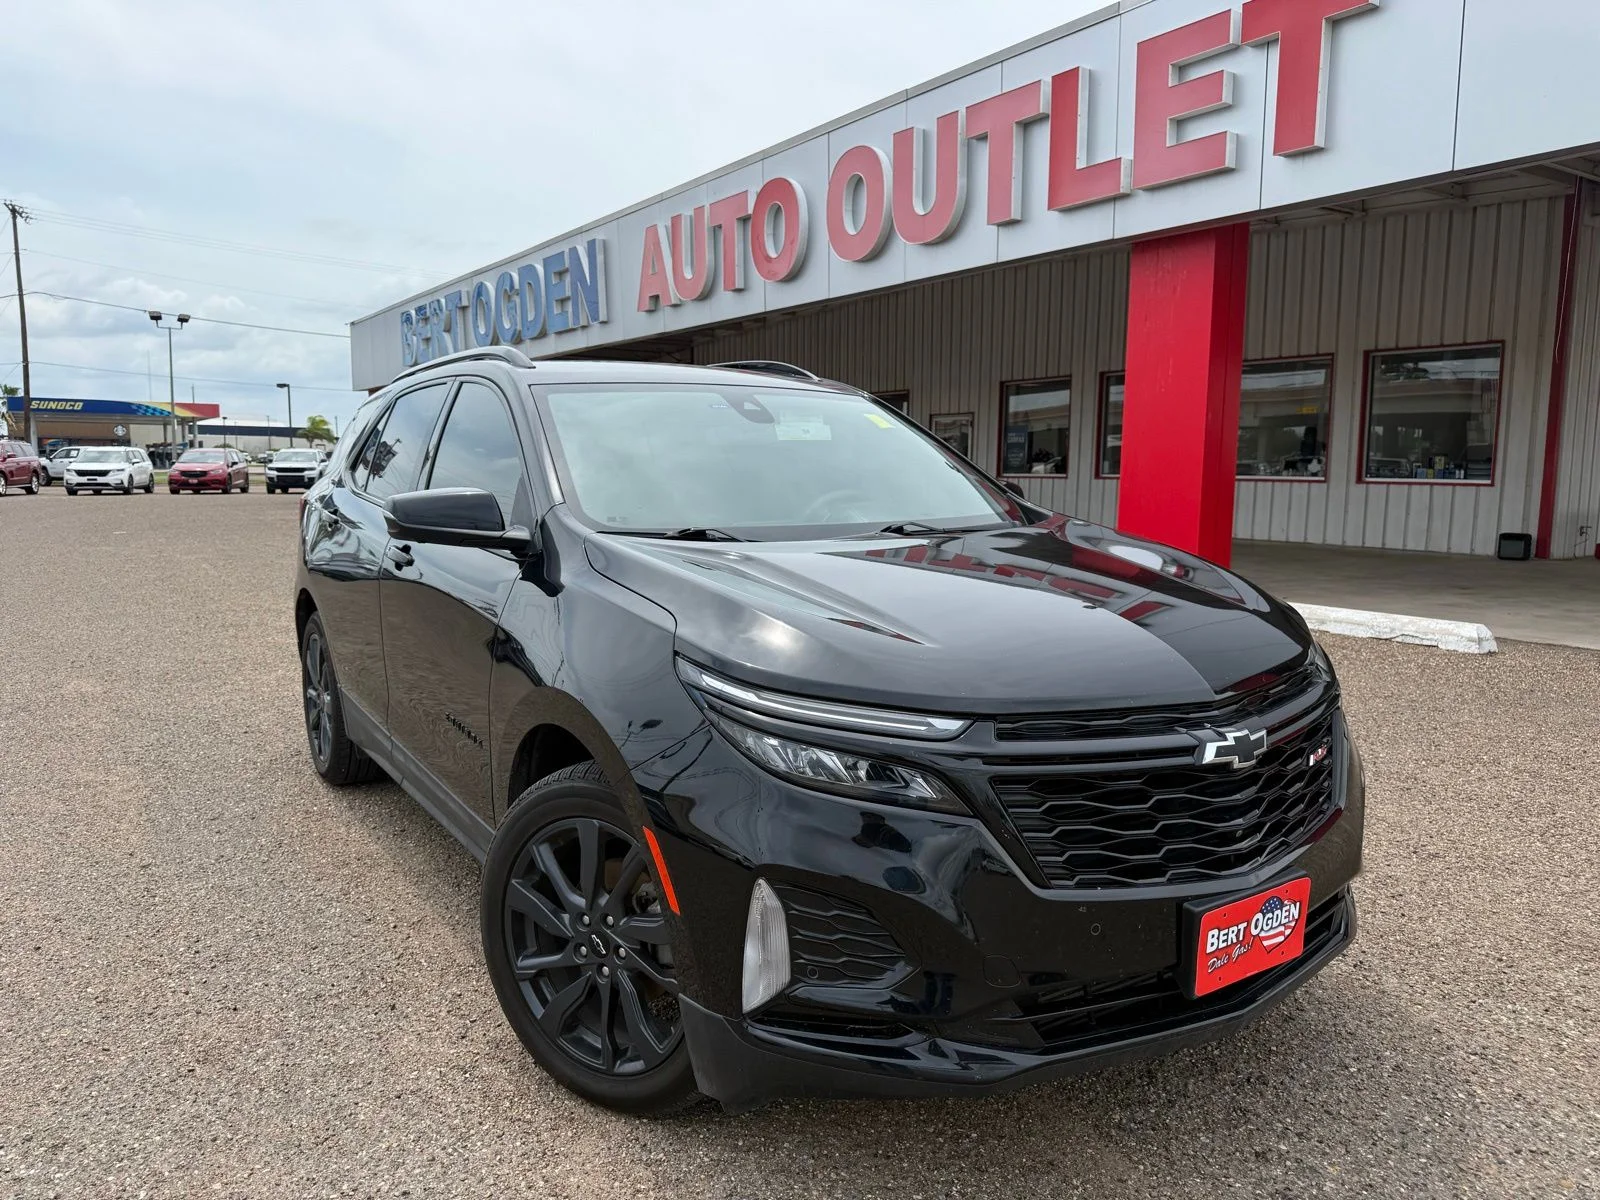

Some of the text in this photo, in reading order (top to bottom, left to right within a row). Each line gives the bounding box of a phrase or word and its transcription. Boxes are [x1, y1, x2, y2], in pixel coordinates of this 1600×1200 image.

[401, 0, 1379, 366] BERT OGDEN AUTO OUTLET
[30, 400, 84, 410] SUNOCO
[1206, 901, 1300, 953] BERT OGDEN
